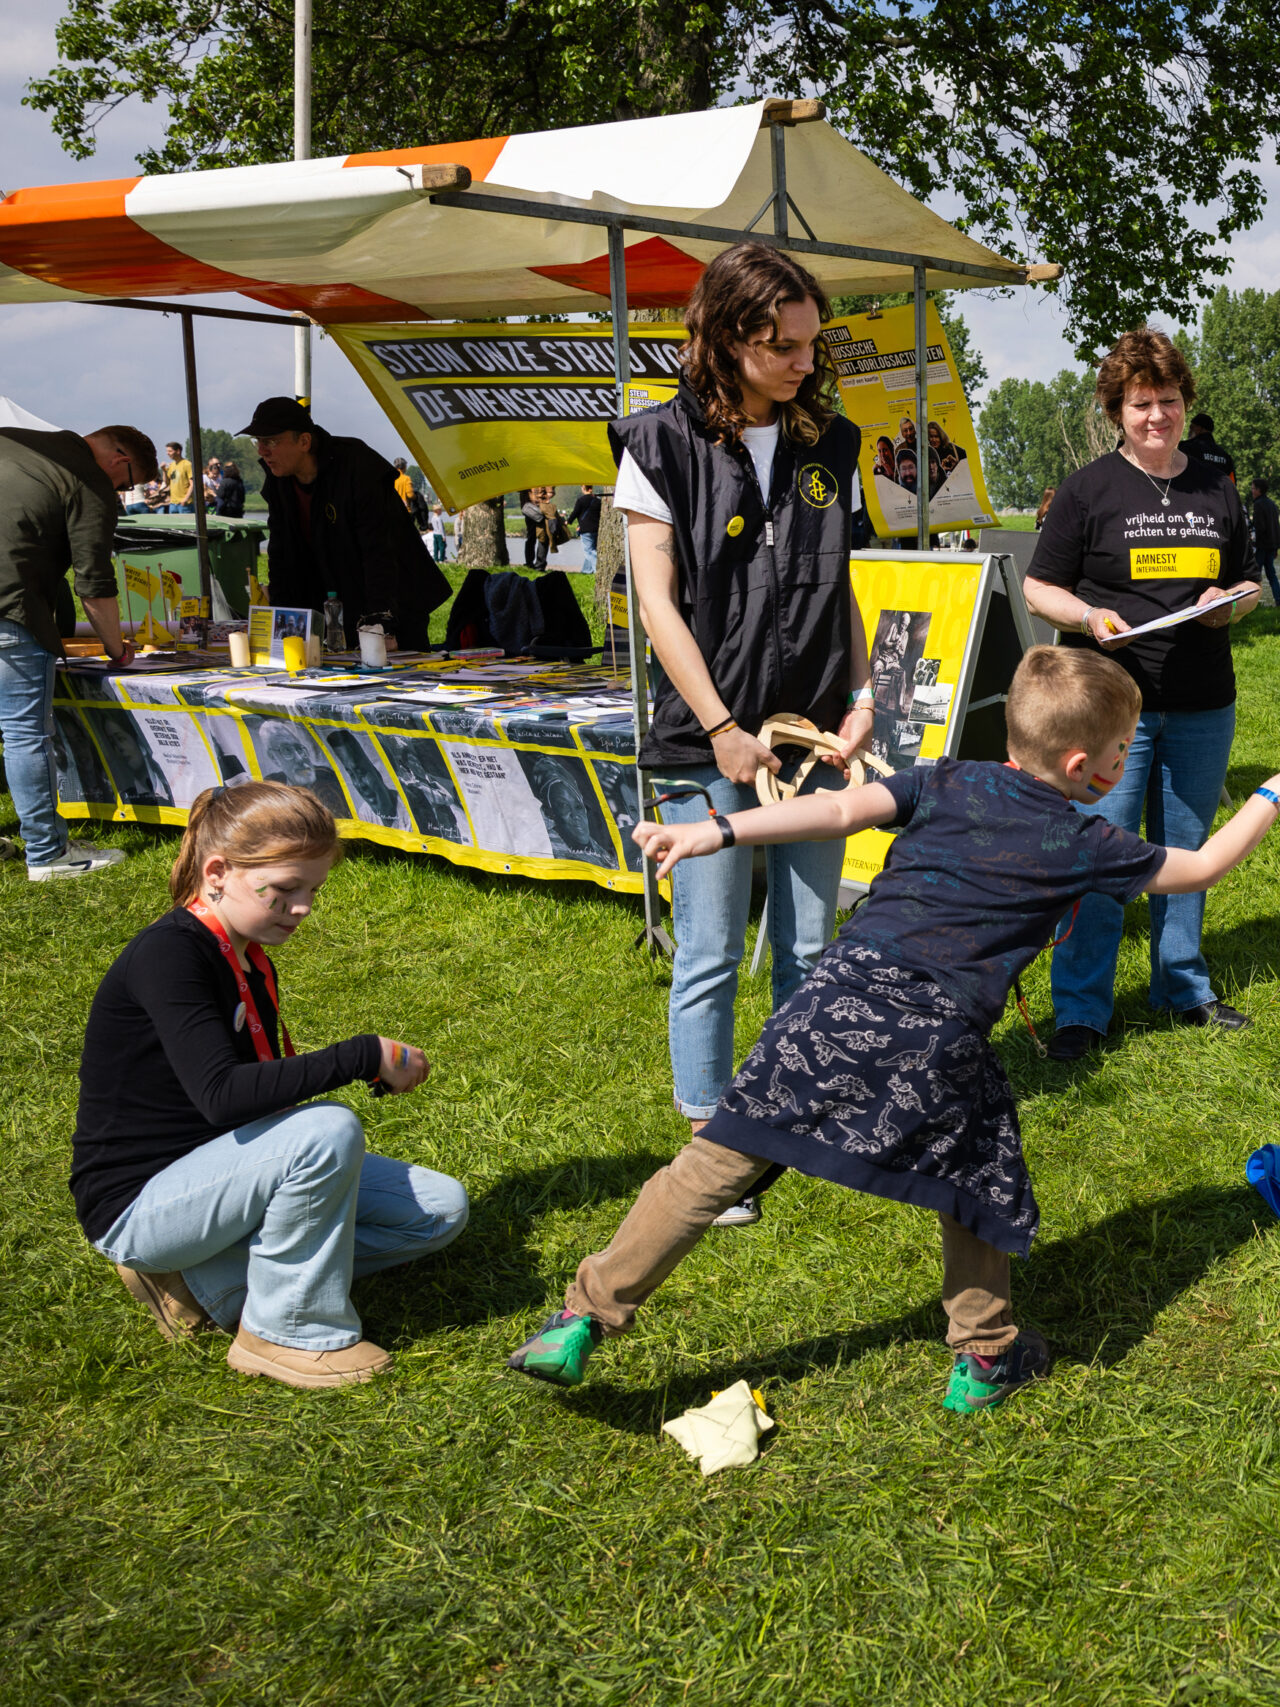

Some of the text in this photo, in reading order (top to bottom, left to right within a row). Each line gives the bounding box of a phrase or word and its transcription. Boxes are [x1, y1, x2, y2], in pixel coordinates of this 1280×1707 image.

[822, 327, 851, 342] STEUN
[373, 342, 473, 375] STEUN
[463, 341, 549, 372] ONZE
[829, 340, 877, 360] RUSSISCHE
[836, 345, 945, 376] ANTI-OORLOGSACTIVTEN
[629, 389, 648, 398] STEUN
[412, 387, 618, 424] DE MENSENREC
[458, 457, 510, 481] amnesty.nl
[1125, 512, 1166, 527] vrijheid
[1167, 515, 1185, 524] om
[1206, 514, 1215, 528] je
[1124, 526, 1221, 539] rechten te genieten
[1135, 553, 1178, 565] AMNESTY
[1135, 565, 1178, 574] INTERNATIONAL
